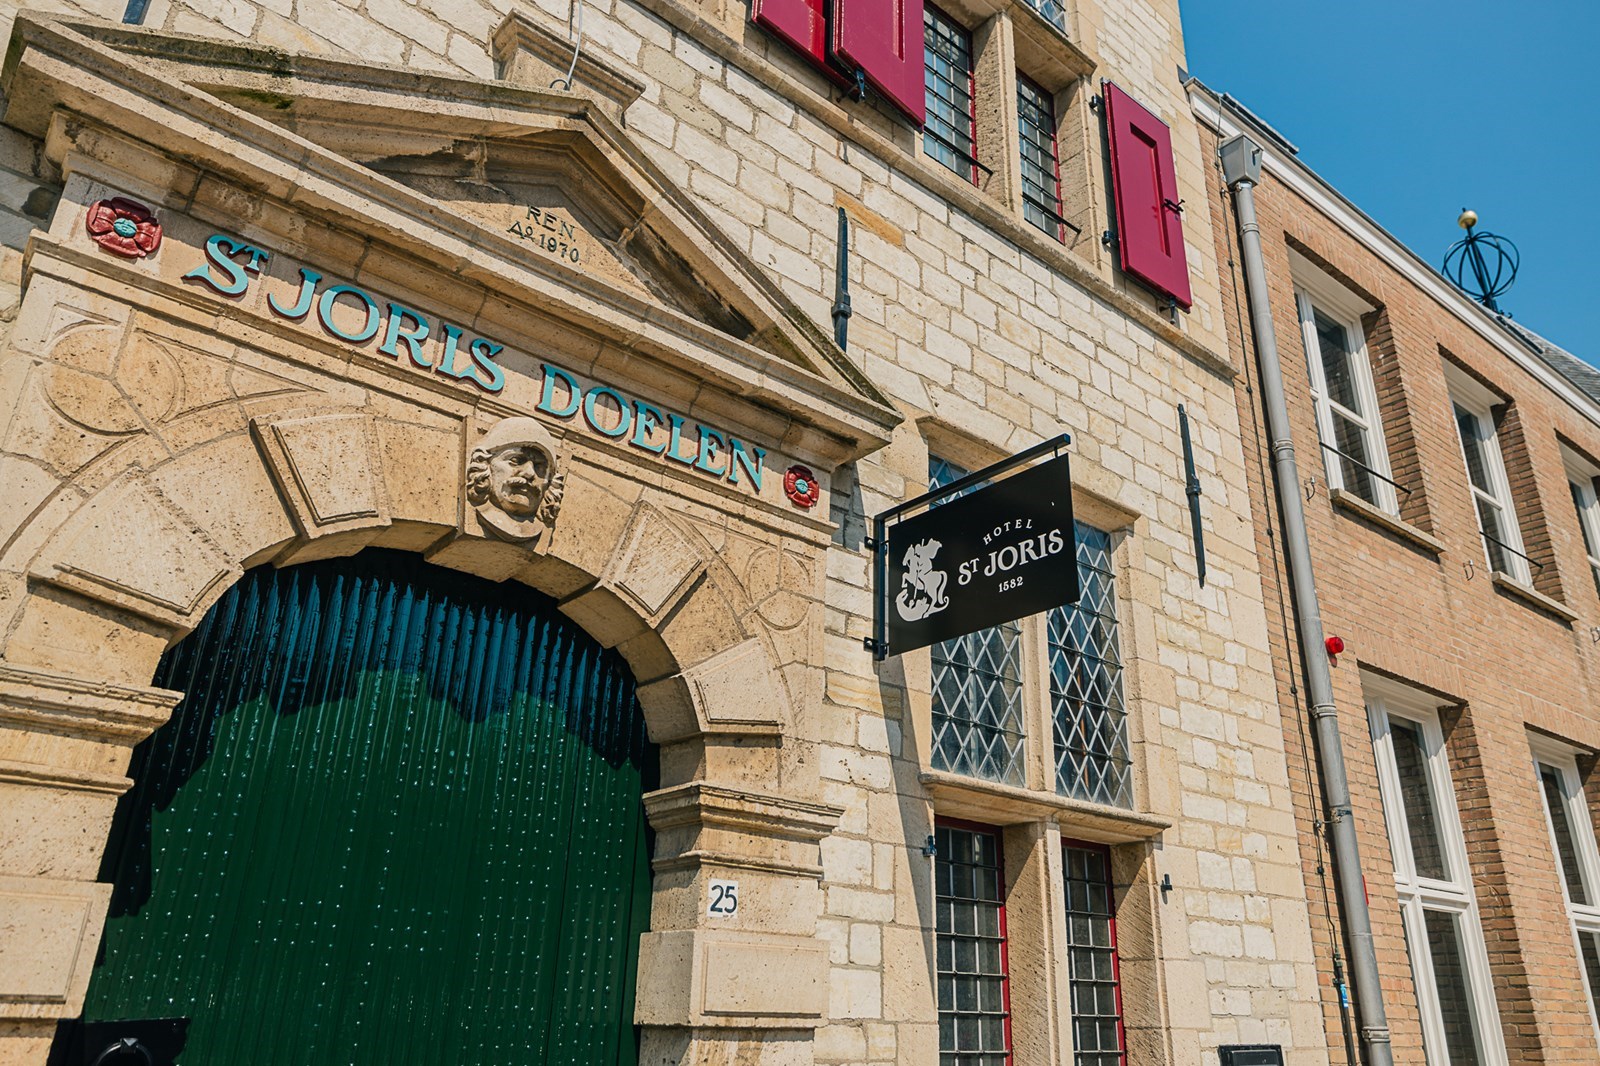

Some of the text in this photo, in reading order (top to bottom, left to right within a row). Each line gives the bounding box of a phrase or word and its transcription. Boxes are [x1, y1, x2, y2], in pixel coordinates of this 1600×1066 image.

[267, 270, 505, 394] JORIS
[535, 362, 766, 493] DOELEN
[983, 519, 1033, 545] HOTEL
[983, 528, 1064, 577] JORIS
[998, 576, 1024, 593] 1582
[709, 884, 737, 914] 25
